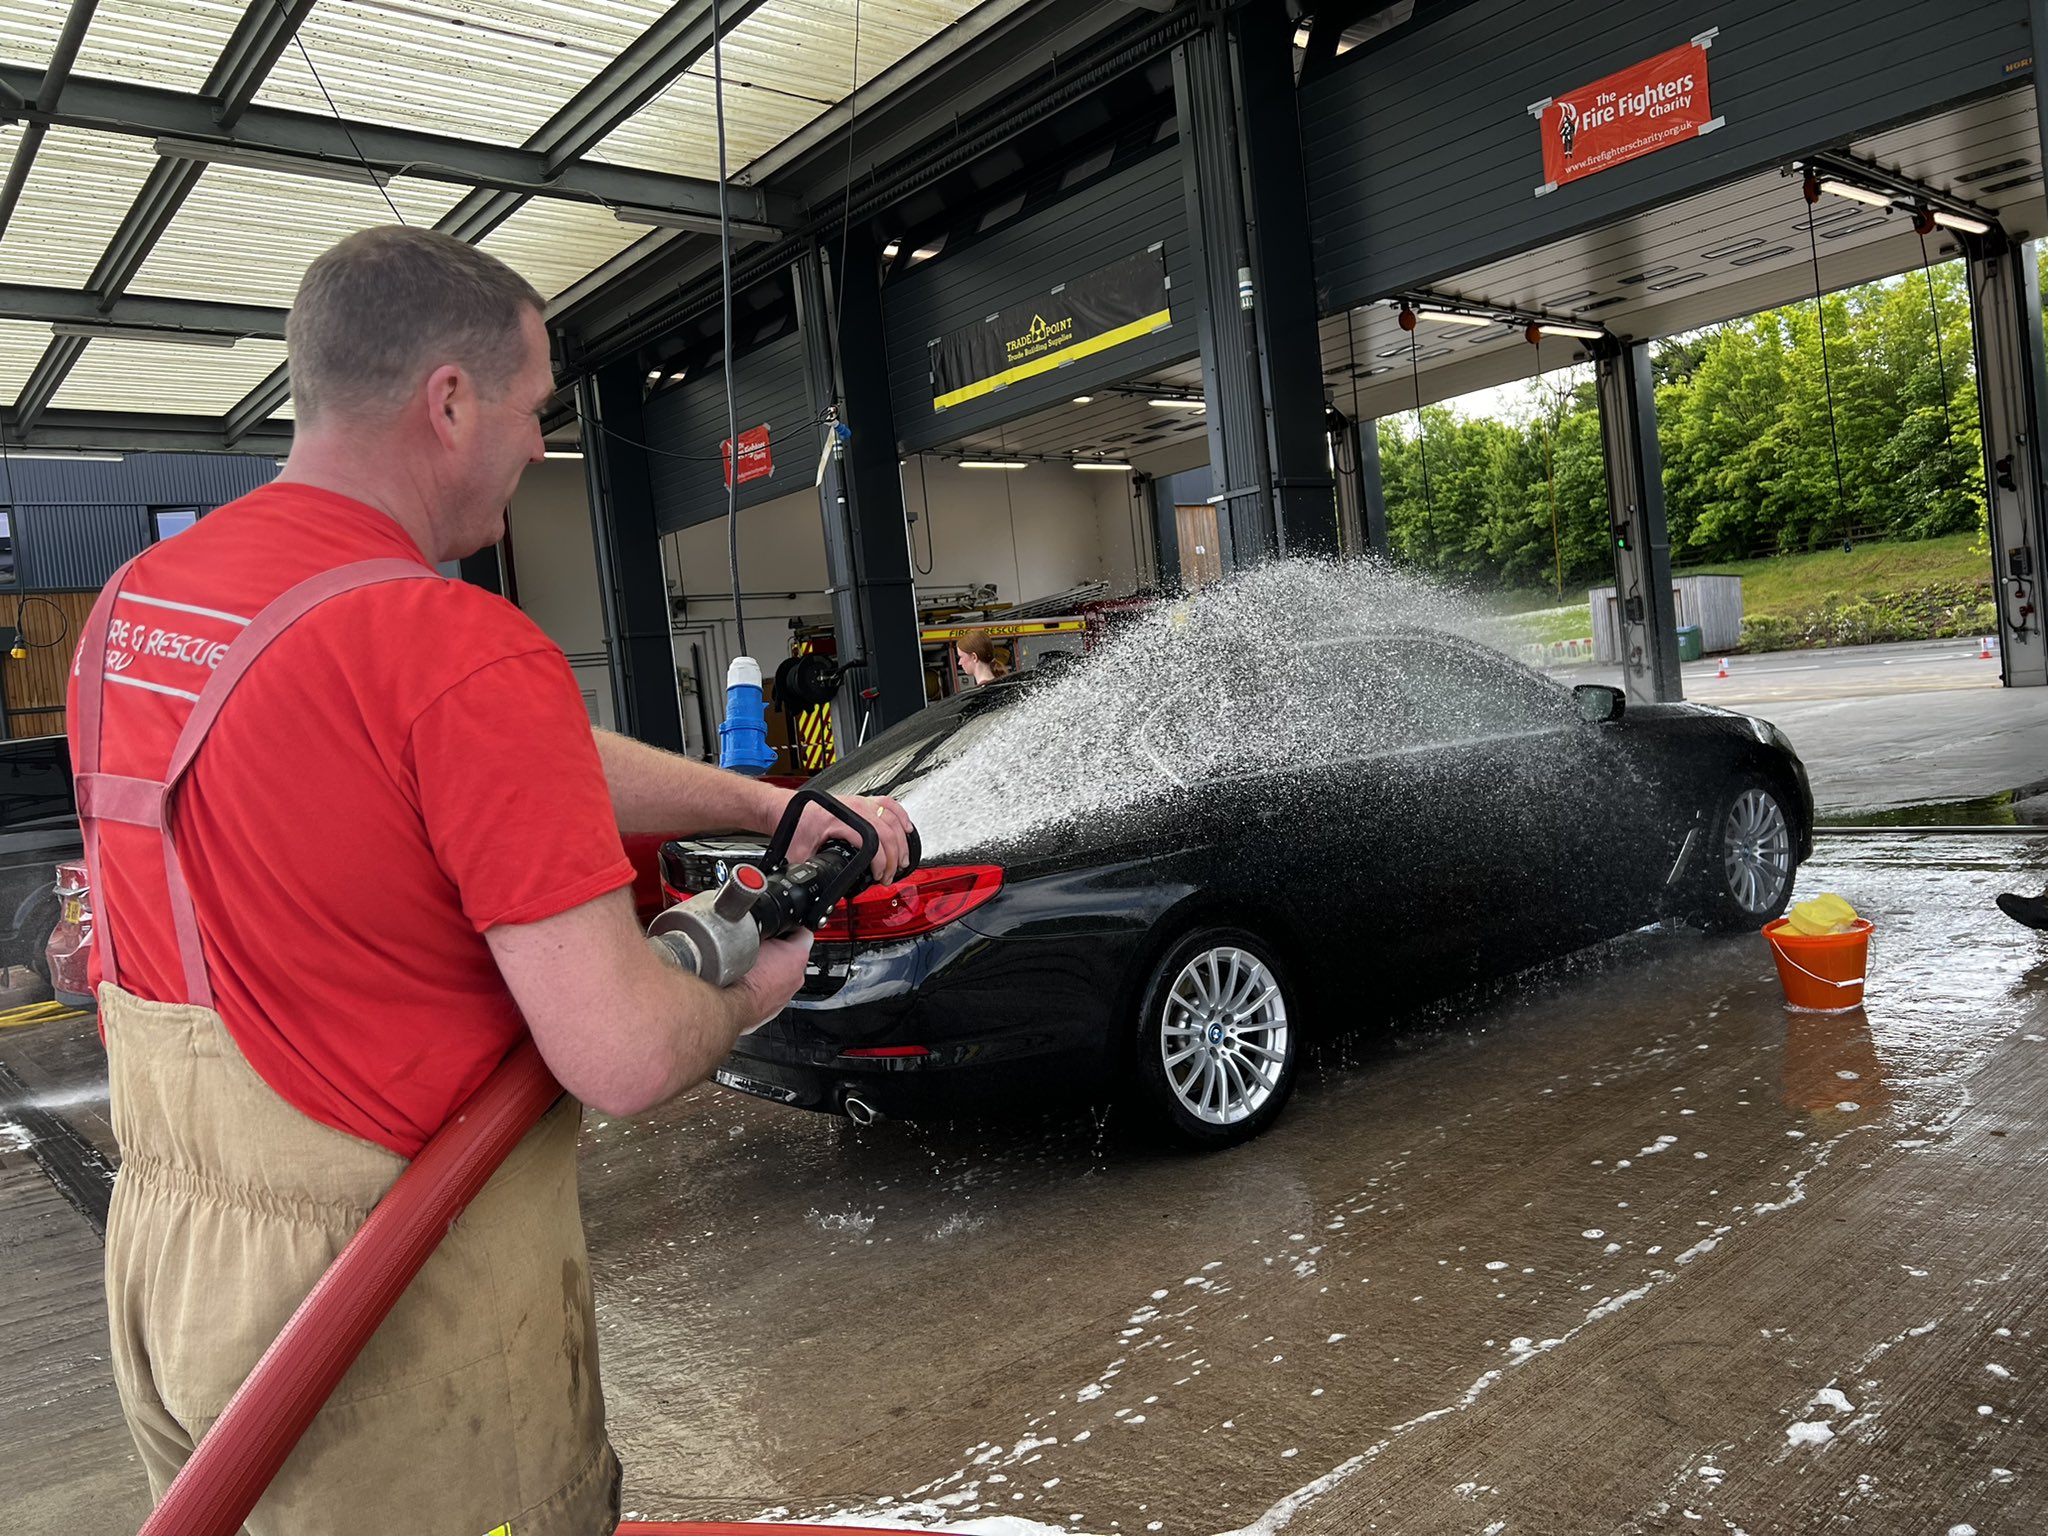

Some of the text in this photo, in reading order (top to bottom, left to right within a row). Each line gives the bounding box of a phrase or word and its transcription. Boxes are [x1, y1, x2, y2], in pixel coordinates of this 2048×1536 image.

[2005, 57, 2033, 72] HOR
[1582, 74, 1694, 131] Fire Fighters
[1596, 91, 1617, 107] The
[1649, 95, 1692, 119] Charity
[1564, 120, 1693, 174] www.firefighterscharity.org.uk
[1006, 317, 1073, 352] TRADE POINT
[107, 618, 131, 648] RE
[144, 628, 231, 670] RESCUE
